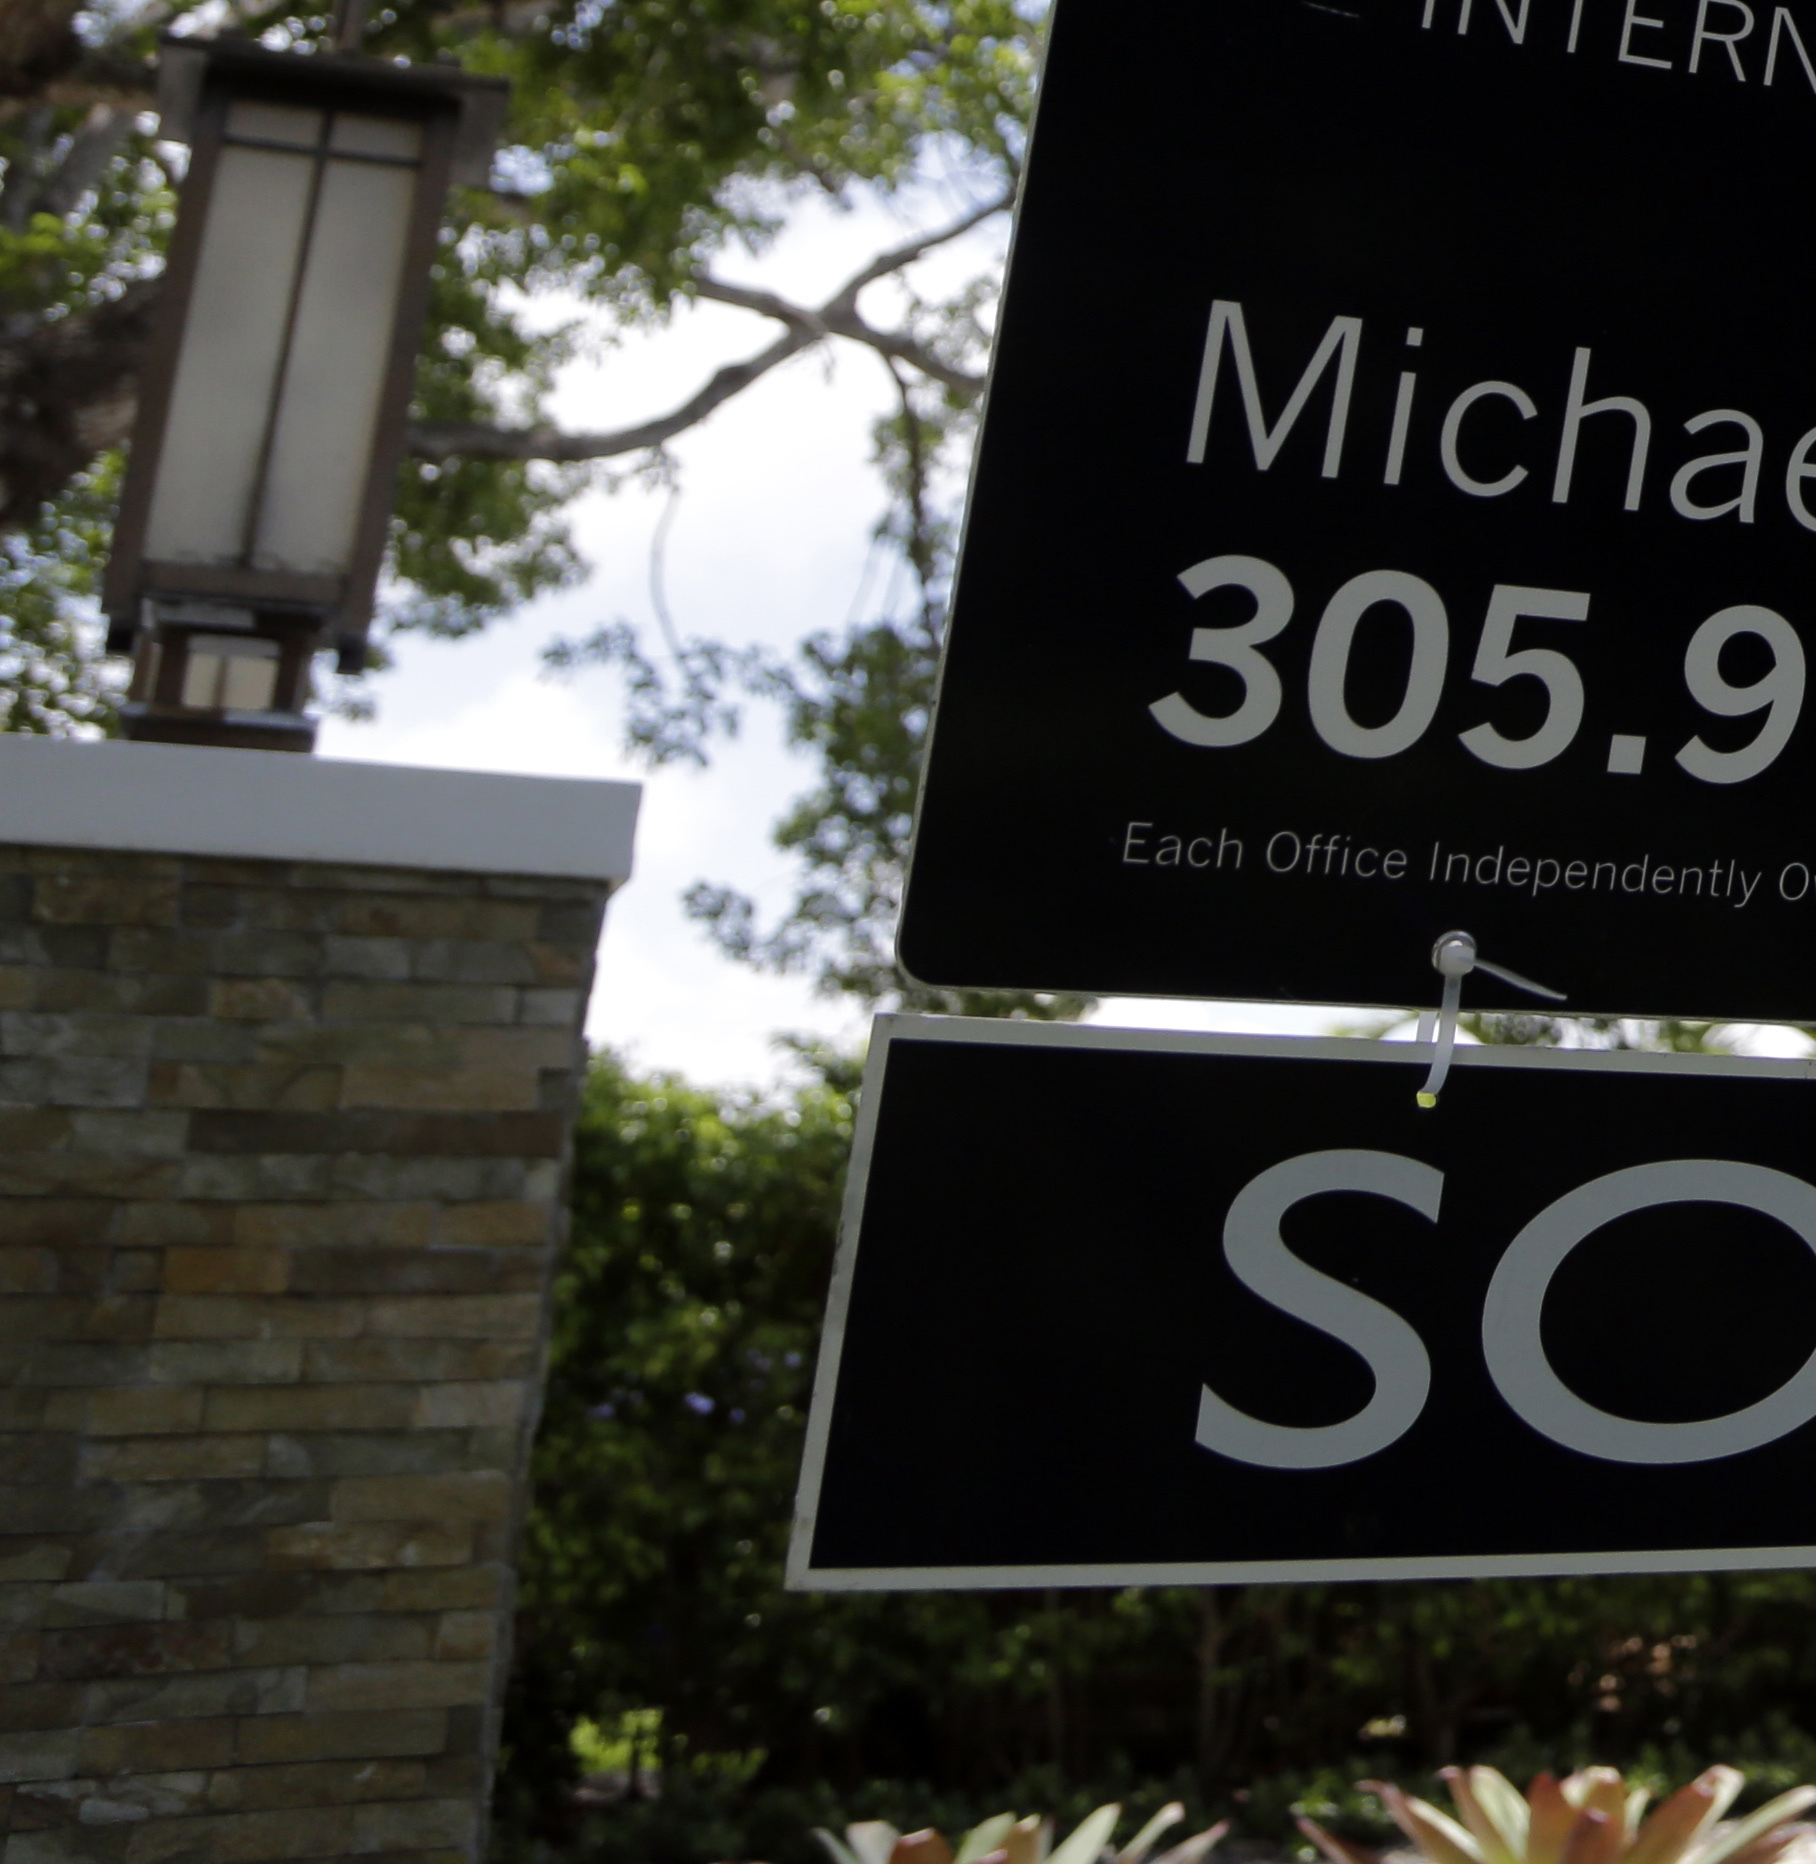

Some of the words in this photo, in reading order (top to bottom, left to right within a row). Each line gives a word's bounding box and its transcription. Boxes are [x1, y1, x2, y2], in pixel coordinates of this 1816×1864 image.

[1121, 820, 1244, 869] Each
[1264, 830, 1408, 880] Office
[1427, 839, 1763, 909] Independently
